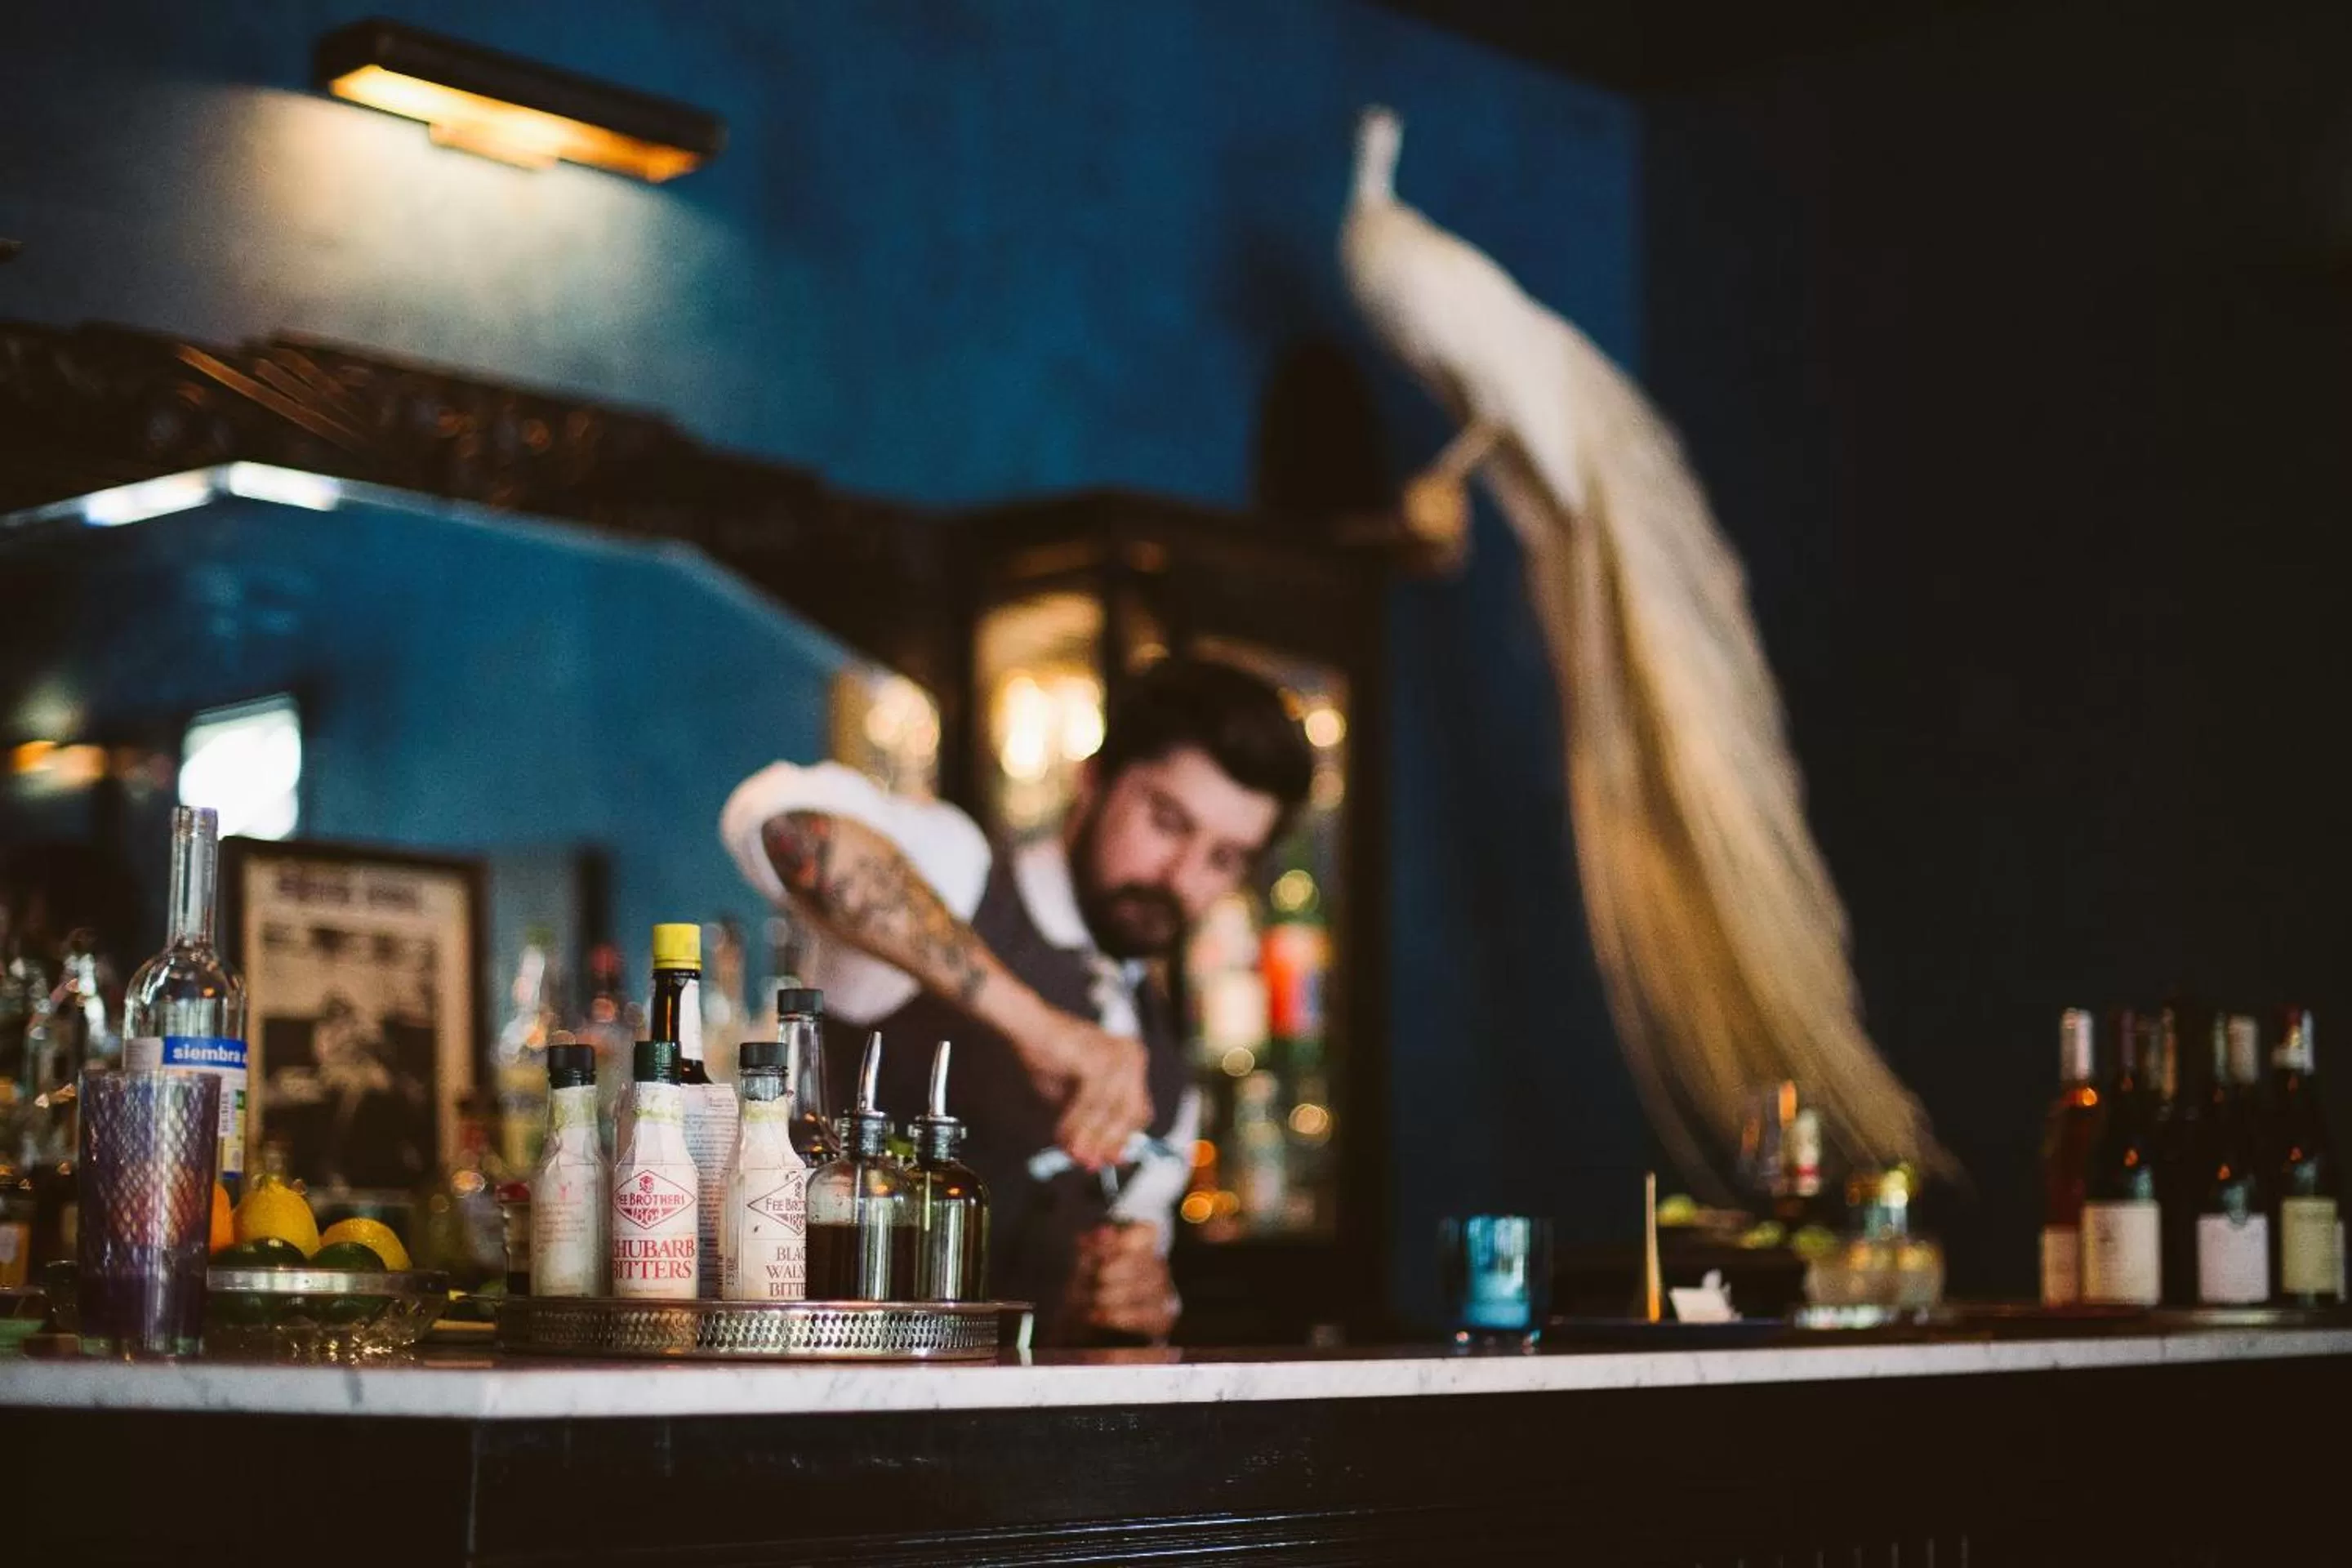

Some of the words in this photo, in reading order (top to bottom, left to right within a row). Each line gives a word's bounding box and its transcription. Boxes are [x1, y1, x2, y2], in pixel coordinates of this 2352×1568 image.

[173, 1044, 241, 1063] siembra
[777, 1246, 806, 1261] BLAC
[765, 1263, 806, 1278] WALN
